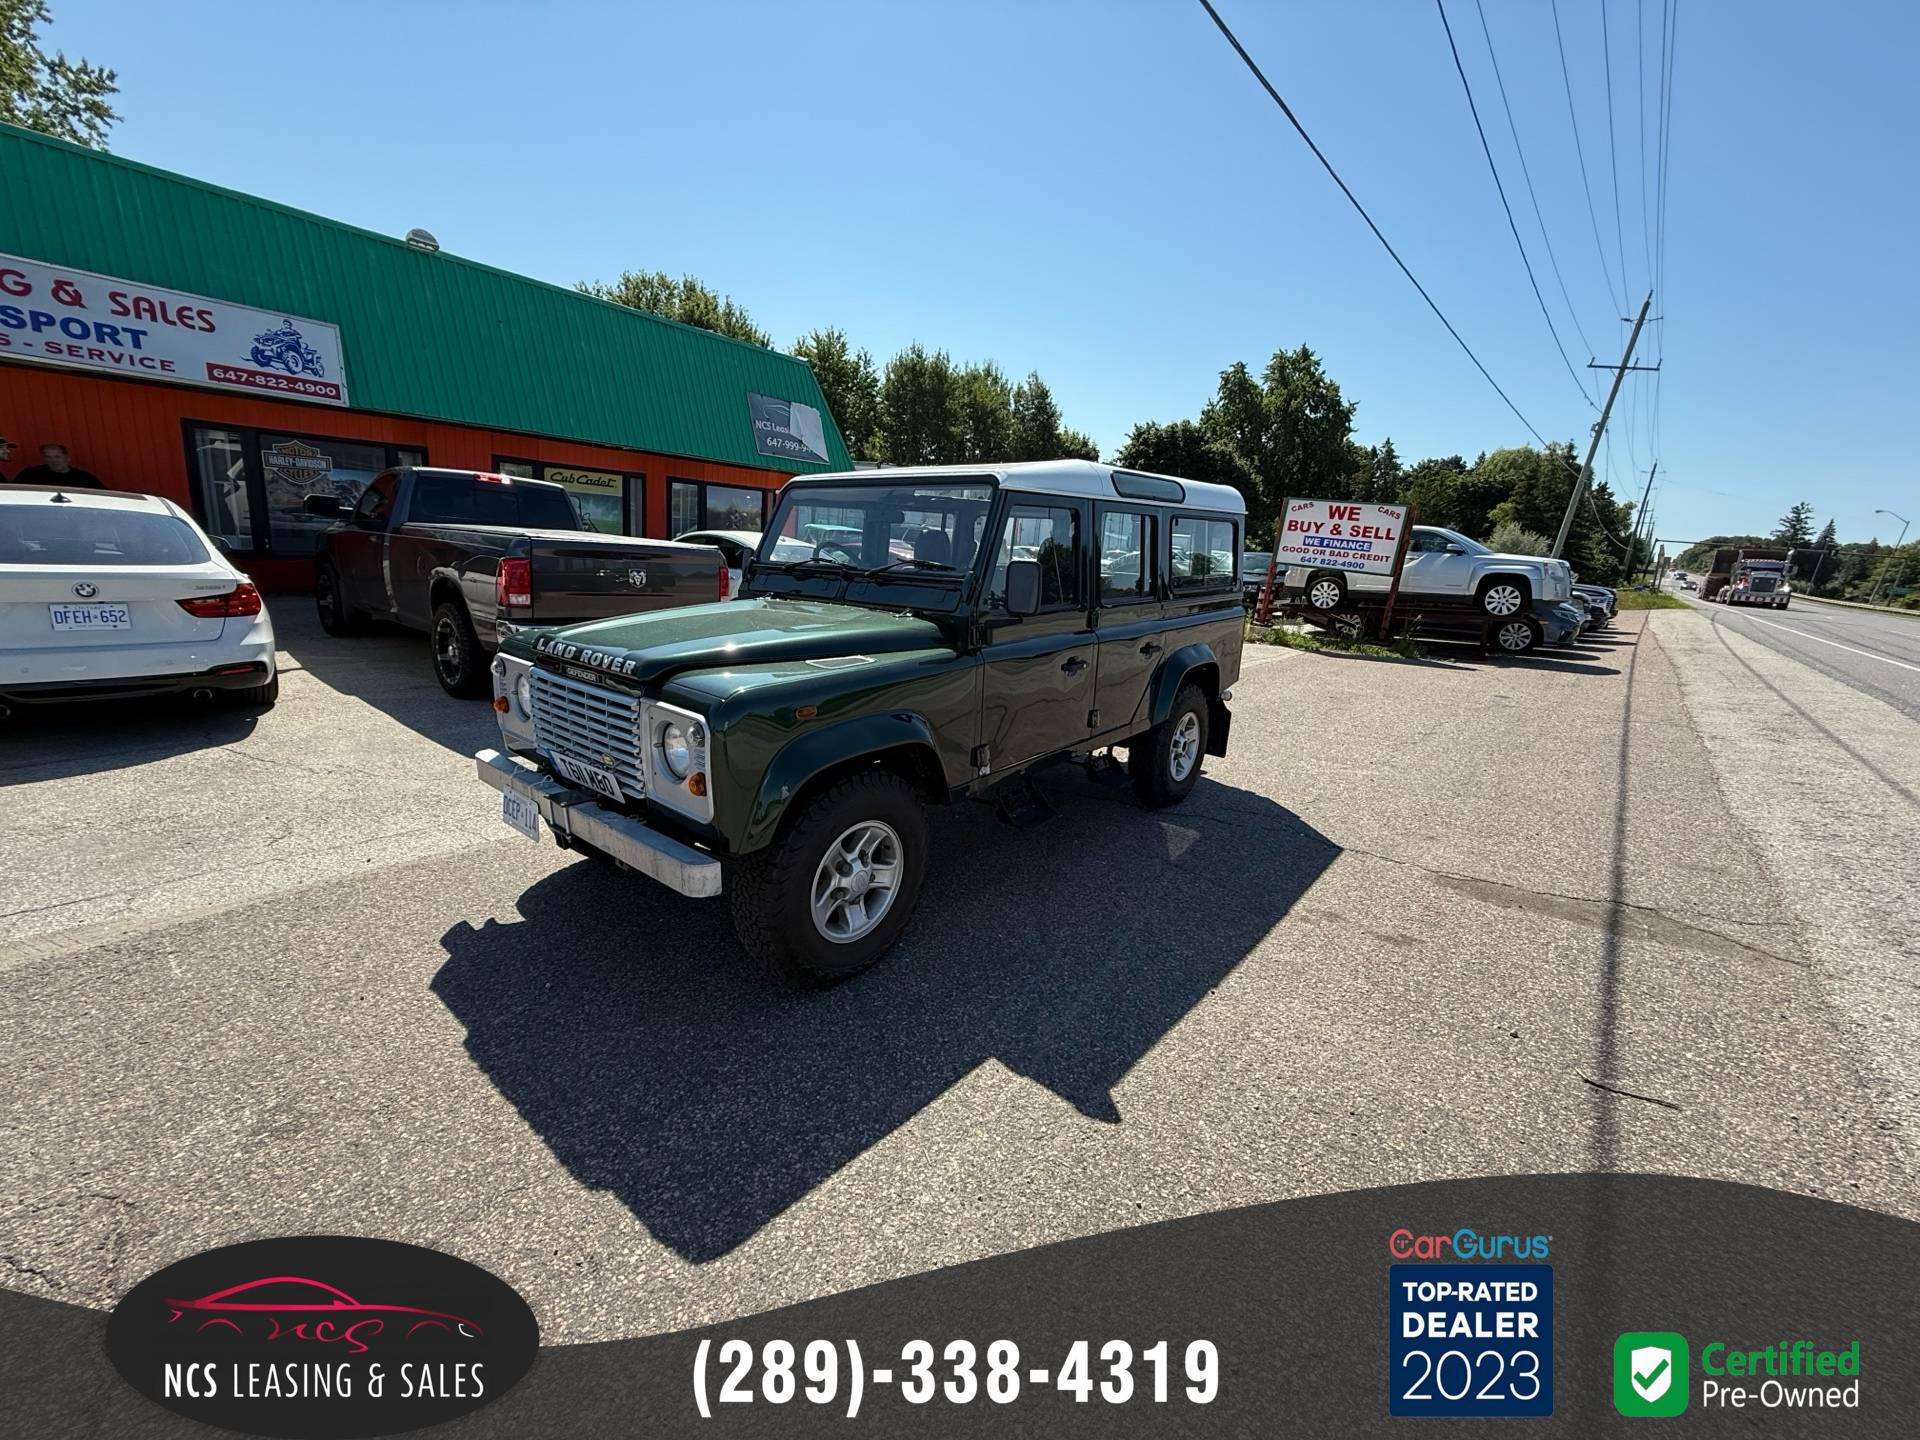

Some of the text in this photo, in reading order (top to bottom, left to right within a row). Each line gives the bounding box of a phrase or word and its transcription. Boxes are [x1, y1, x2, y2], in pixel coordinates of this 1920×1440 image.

[51, 279, 88, 309] &
[108, 290, 216, 333] SALES
[45, 341, 176, 372] SERVICE
[212, 367, 337, 396] 647-822-4900
[755, 420, 771, 431] NCS
[550, 471, 617, 488] Cub Cadet
[1291, 502, 1314, 512] CARS
[1328, 505, 1362, 521] WE
[1377, 506, 1401, 520] CARS
[1287, 520, 1396, 541] BUY & SELL
[1304, 537, 1371, 551] WE FINANCE
[1282, 545, 1391, 563] GOOD OR BAD CREDIT
[1300, 556, 1365, 570] 647 822-4900
[536, 638, 636, 675] LAND ROVER
